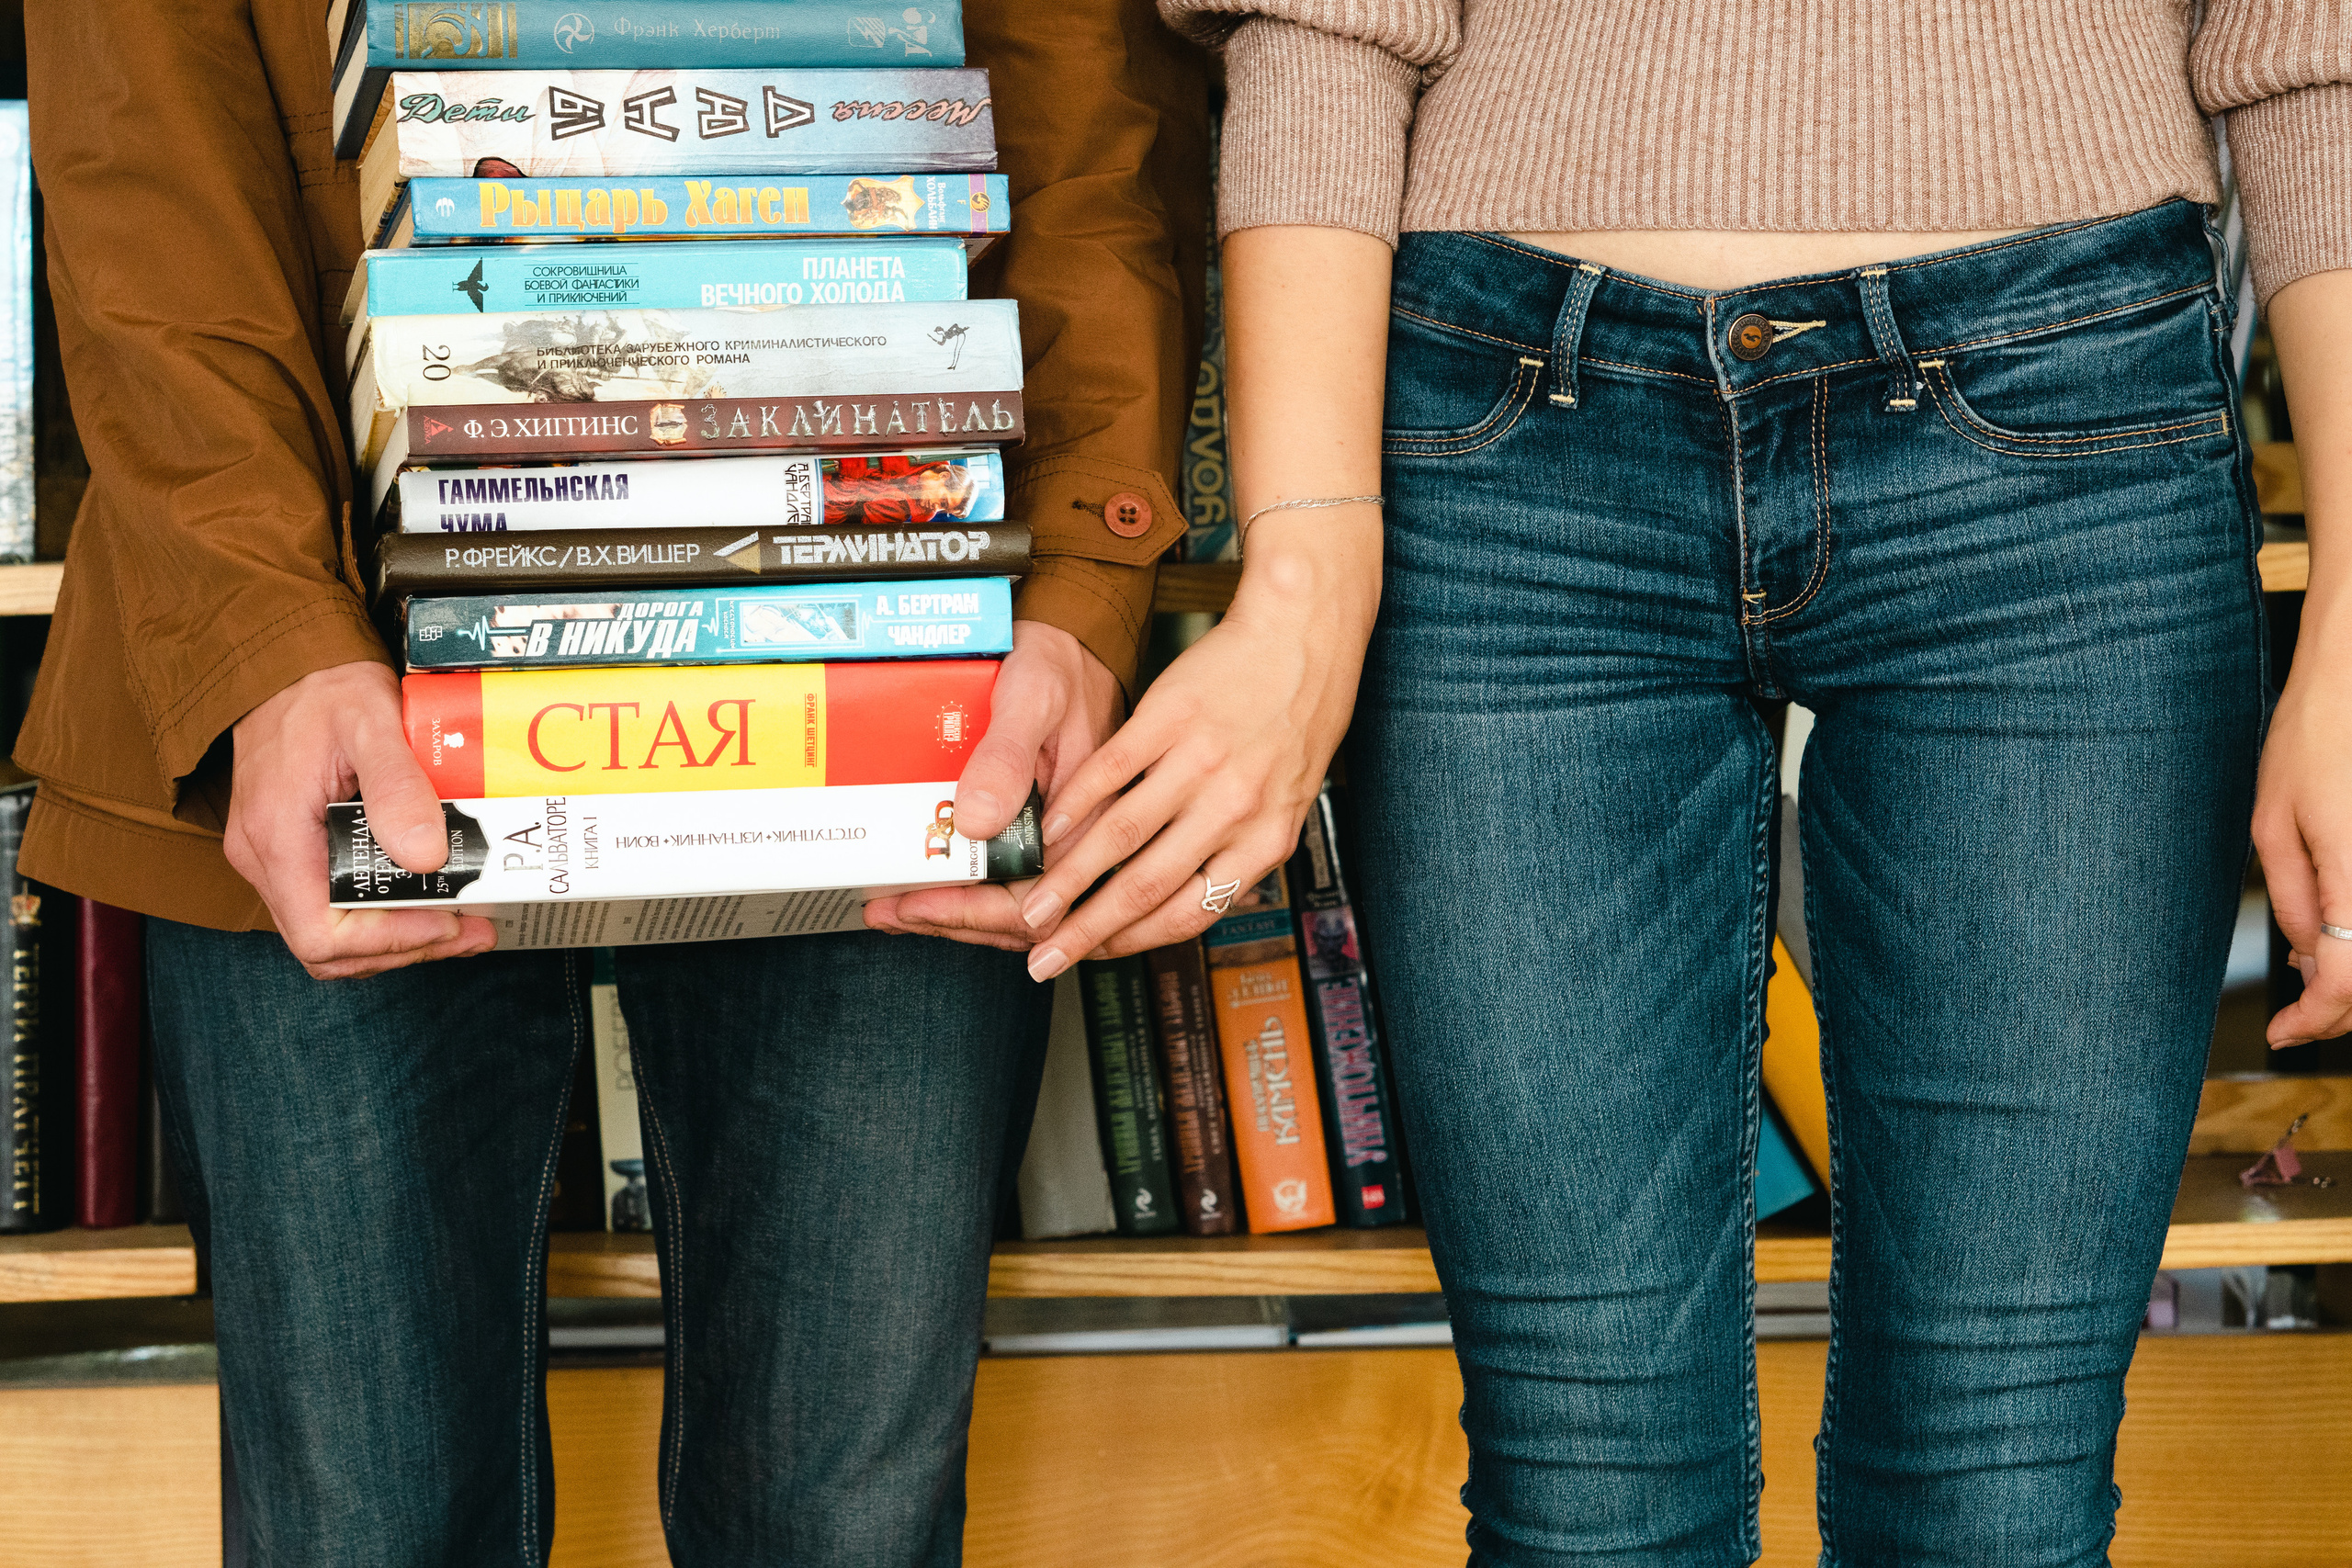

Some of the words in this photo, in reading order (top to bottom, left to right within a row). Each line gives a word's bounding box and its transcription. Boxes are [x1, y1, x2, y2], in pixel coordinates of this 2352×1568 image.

[614, 17, 678, 40] Фрэнк
[694, 18, 781, 43] Херберт
[396, 93, 536, 123] Дети
[829, 96, 992, 128] Мессия
[479, 182, 669, 233] Рыцарь
[684, 180, 810, 228] Хаген
[926, 176, 938, 229] ХОЛЬБАЙН
[937, 182, 946, 223] Вольфганг
[525, 278, 567, 289] БОЕВОЙ
[571, 278, 639, 289] ФАНТАСТИКИ
[533, 265, 628, 276] СОКРОВИЩНИЦА
[802, 256, 905, 281] ПЛАНЕТА
[537, 293, 546, 303] И
[548, 290, 628, 303] ПРИКЛЮЧЕНИЙ
[701, 283, 803, 306] ВЕЧНОГО
[809, 281, 905, 304] ХОЛОДА
[537, 344, 622, 357] БИБЛИОТЕКА
[626, 339, 720, 355] ЗАРУБЕЖНОГО
[725, 335, 888, 351] КРИМИНАЛИСТИЧЕСКОГО
[537, 357, 546, 369] И
[549, 355, 690, 369] ПРИКЛЮЧЕНЧЕСКОГО
[696, 353, 751, 366] РОМАНА
[423, 344, 452, 381] 20
[423, 415, 432, 445] АЗБУКА
[514, 414, 639, 437] ХИГГИНС
[700, 397, 1014, 439] ЗАКЛИНАТЕЛЬ
[437, 473, 629, 505] ГАММЕЛЬНСКАЯ
[439, 513, 508, 532] ЧУМА
[773, 531, 990, 565] ТЕРМИНАТОР
[617, 601, 704, 621] ДОРОГА
[900, 593, 978, 615] БЕРТРАМ
[525, 622, 552, 657] В
[558, 619, 699, 659] НИКУДА
[888, 623, 970, 649] ЧАНДЛЕР
[807, 694, 815, 723] ФРАНК
[431, 717, 442, 766] ЗАХАРОВ
[526, 699, 757, 772] СТАЯ
[944, 712, 955, 742] ТРИЛЛЕР
[806, 726, 816, 768] ШЕТЦИНГ
[671, 831, 763, 848] ИЗГНАННИК
[773, 828, 866, 844] ОТСТУПНИК
[1023, 806, 1035, 845] FANTASTIKA
[352, 817, 371, 892] ЛЕГЕНДА
[450, 829, 464, 869] EDITION
[546, 796, 570, 894] САЛЬВАТОРЕ
[583, 824, 599, 869] КНИГА
[616, 835, 659, 849] ВОИН
[373, 842, 391, 885] ТЕМ
[969, 840, 978, 877] FORGOT
[1317, 975, 1388, 1168] УНИЧТОЖЕНИЕ
